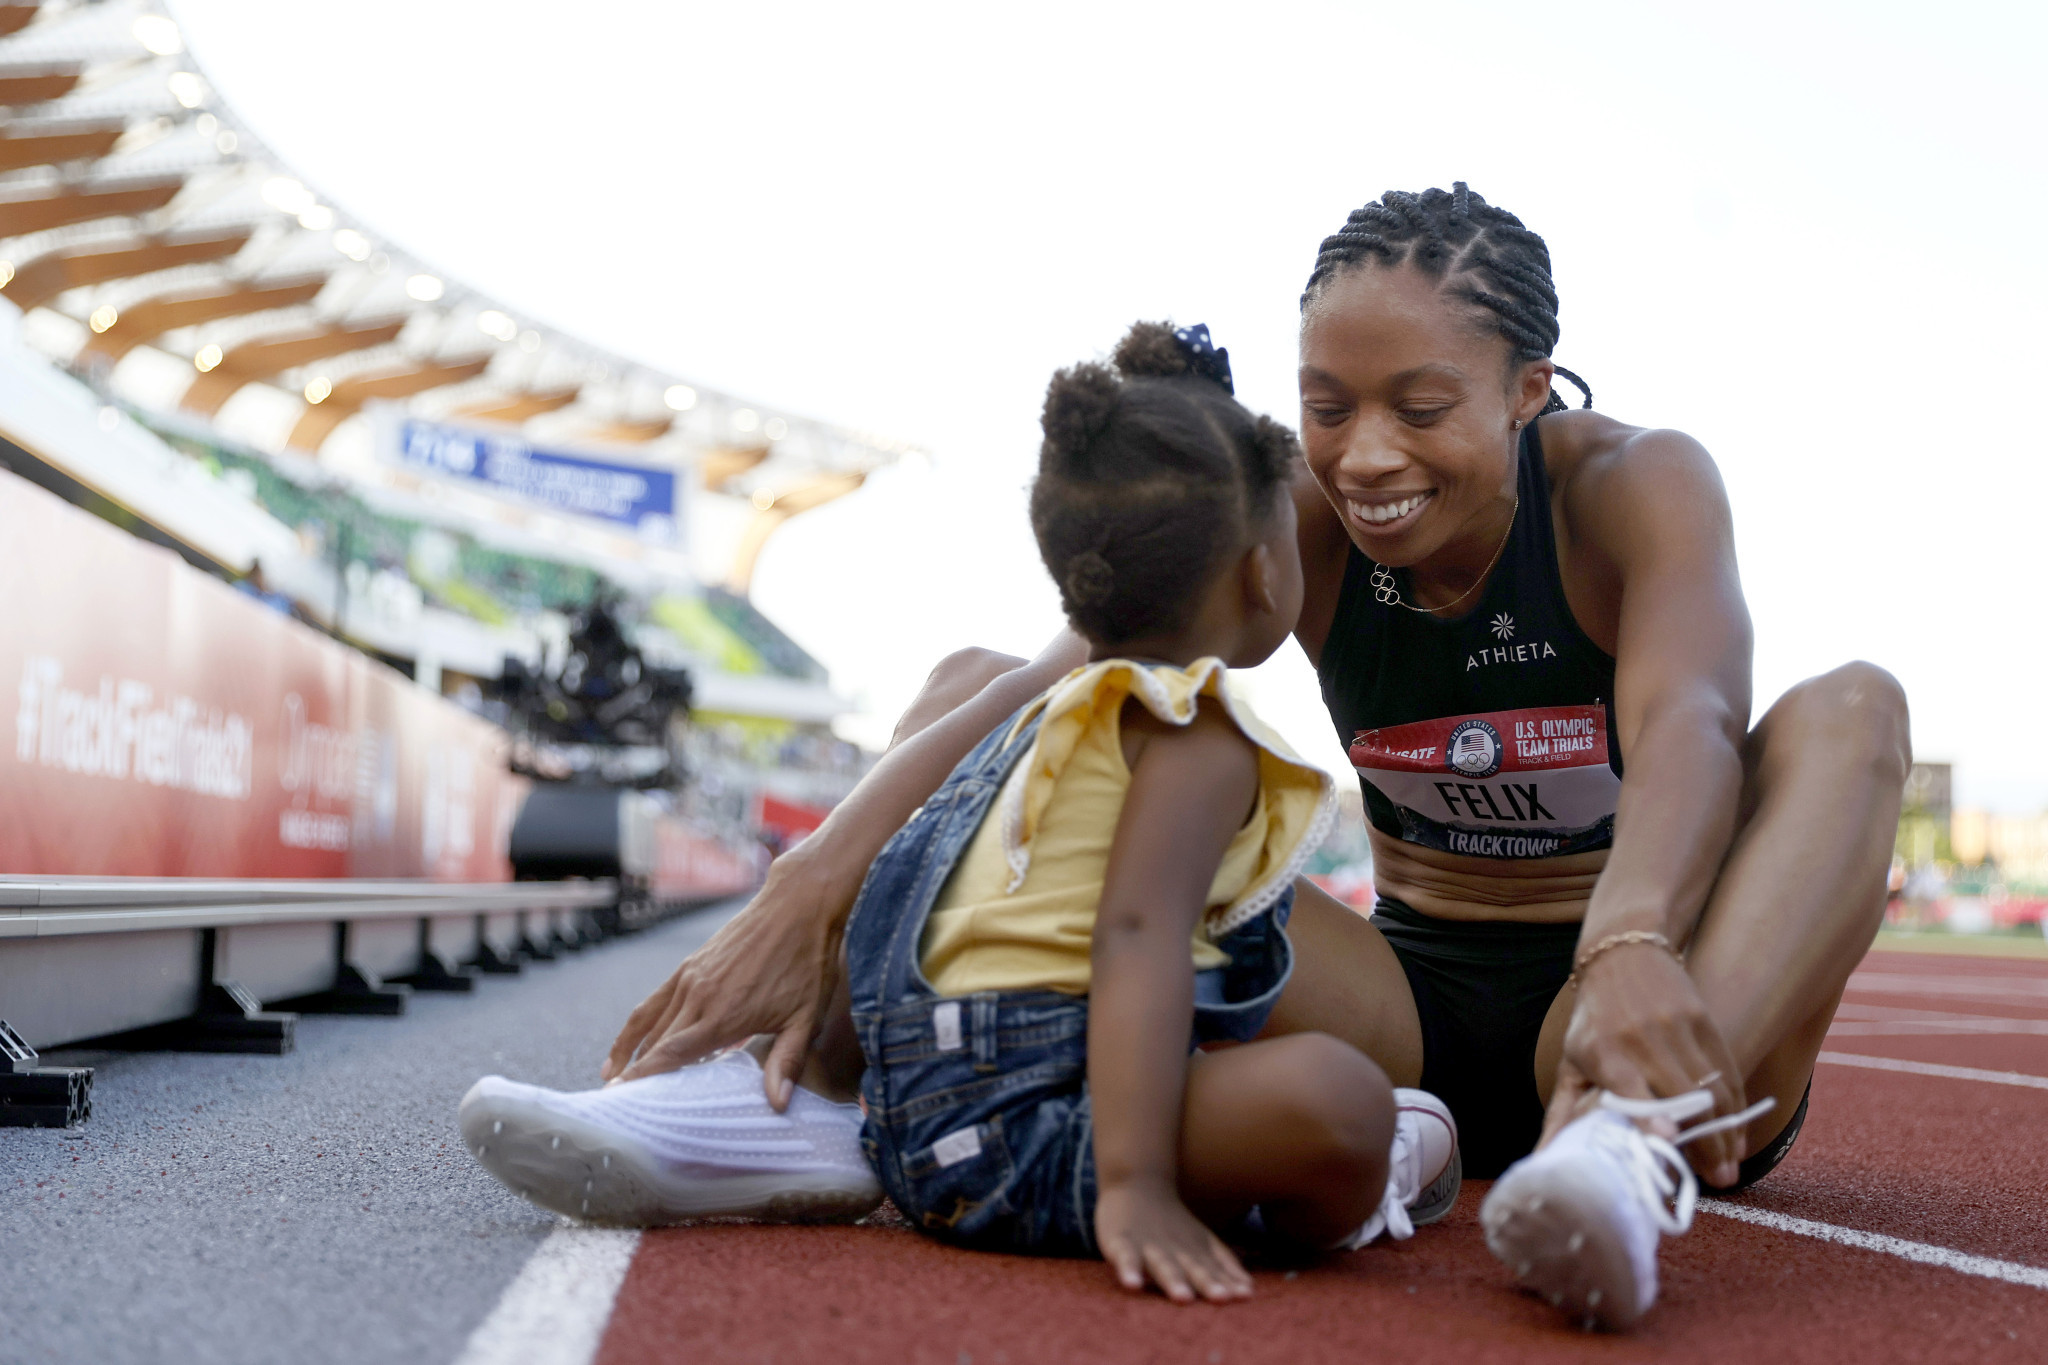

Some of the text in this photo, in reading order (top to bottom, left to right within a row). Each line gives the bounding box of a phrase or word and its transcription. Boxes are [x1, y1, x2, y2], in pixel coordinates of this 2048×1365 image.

[1466, 641, 1557, 671] ATHLETA
[1450, 721, 1496, 741] UNITED STATES
[1515, 717, 1594, 739] U.S. OLYMPIC
[1515, 735, 1593, 757] TEAM TRIALS
[1517, 757, 1543, 765] TRACK
[1550, 753, 1571, 762] FIELD
[1433, 782, 1557, 821] FELIX
[1447, 829, 1559, 857] TRACKTOWN
